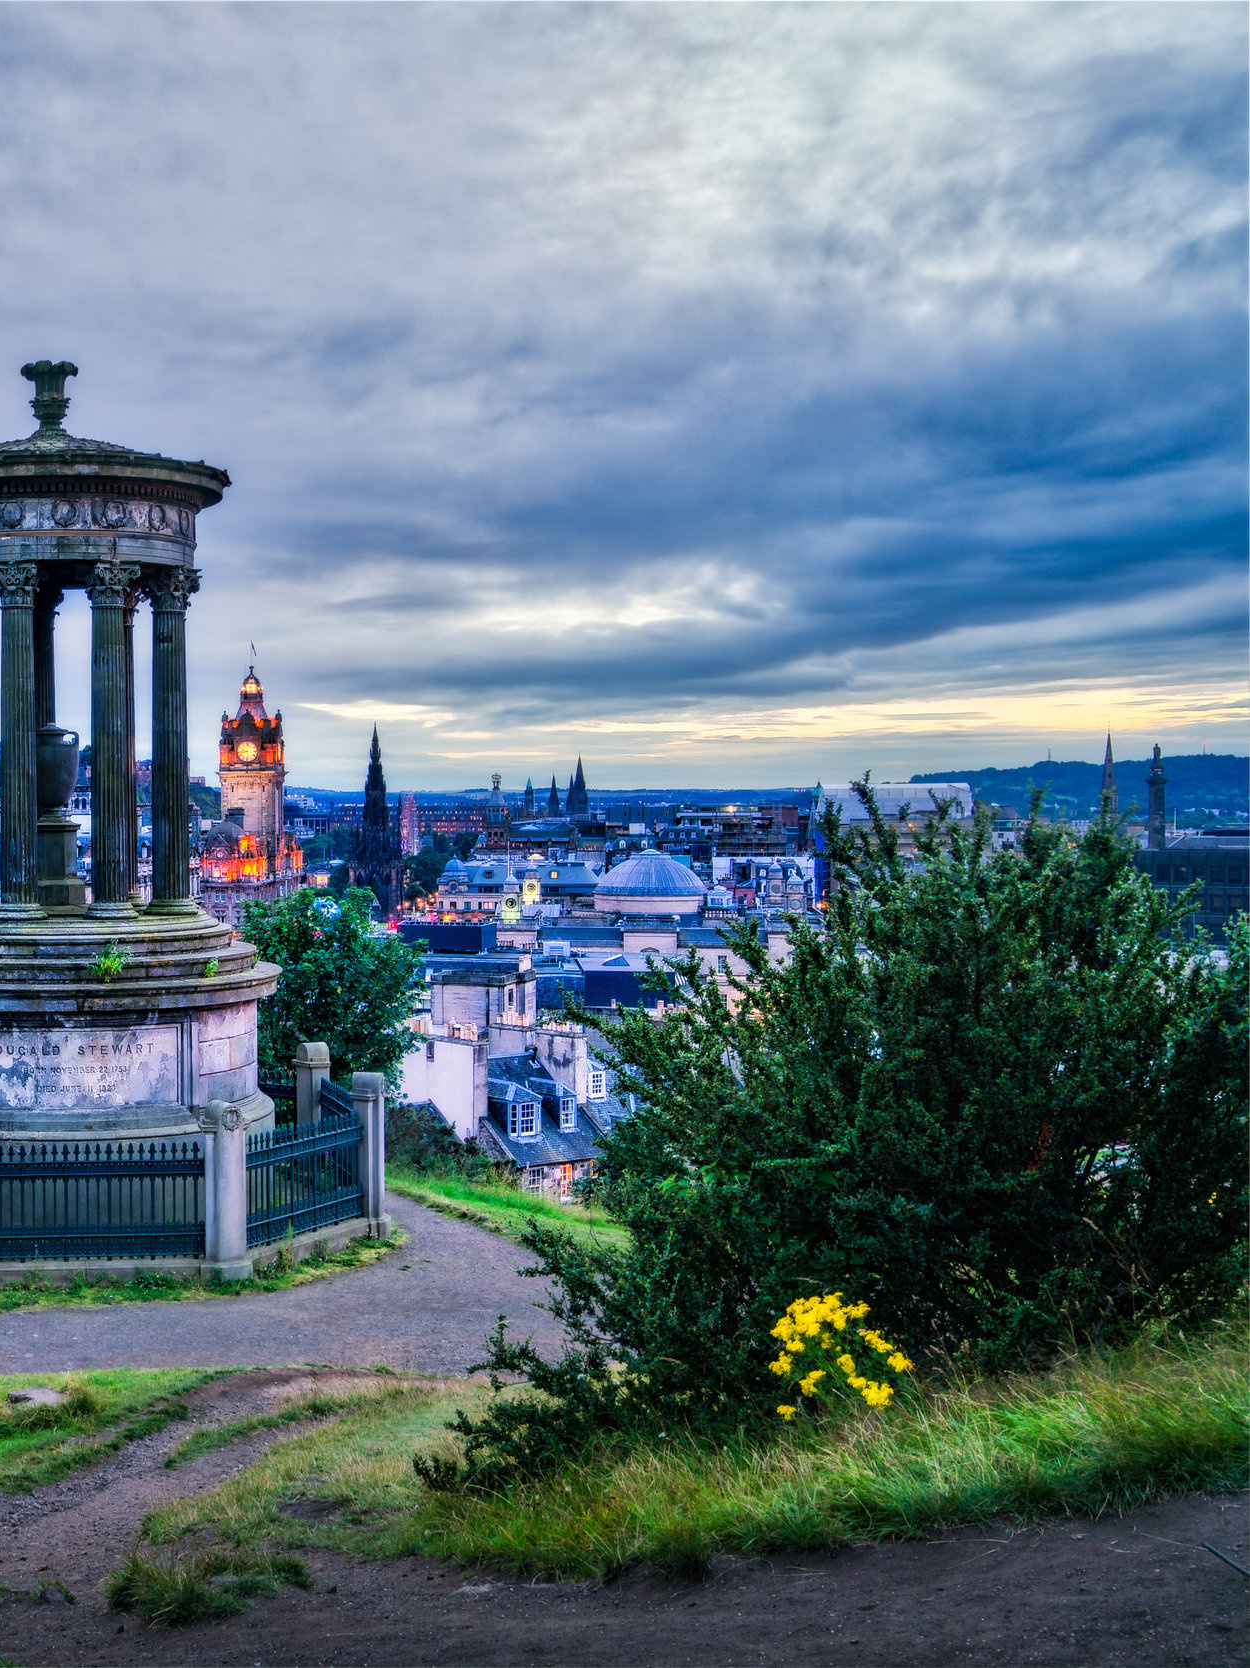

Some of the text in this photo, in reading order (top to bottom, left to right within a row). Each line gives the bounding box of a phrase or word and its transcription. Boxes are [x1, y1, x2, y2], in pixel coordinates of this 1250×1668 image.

[77, 1043, 154, 1056] STEWART
[23, 1065, 128, 1075] BORN NOVEMBER 22 1753
[37, 1085, 57, 1093] DIED
[87, 1085, 94, 1093] 11
